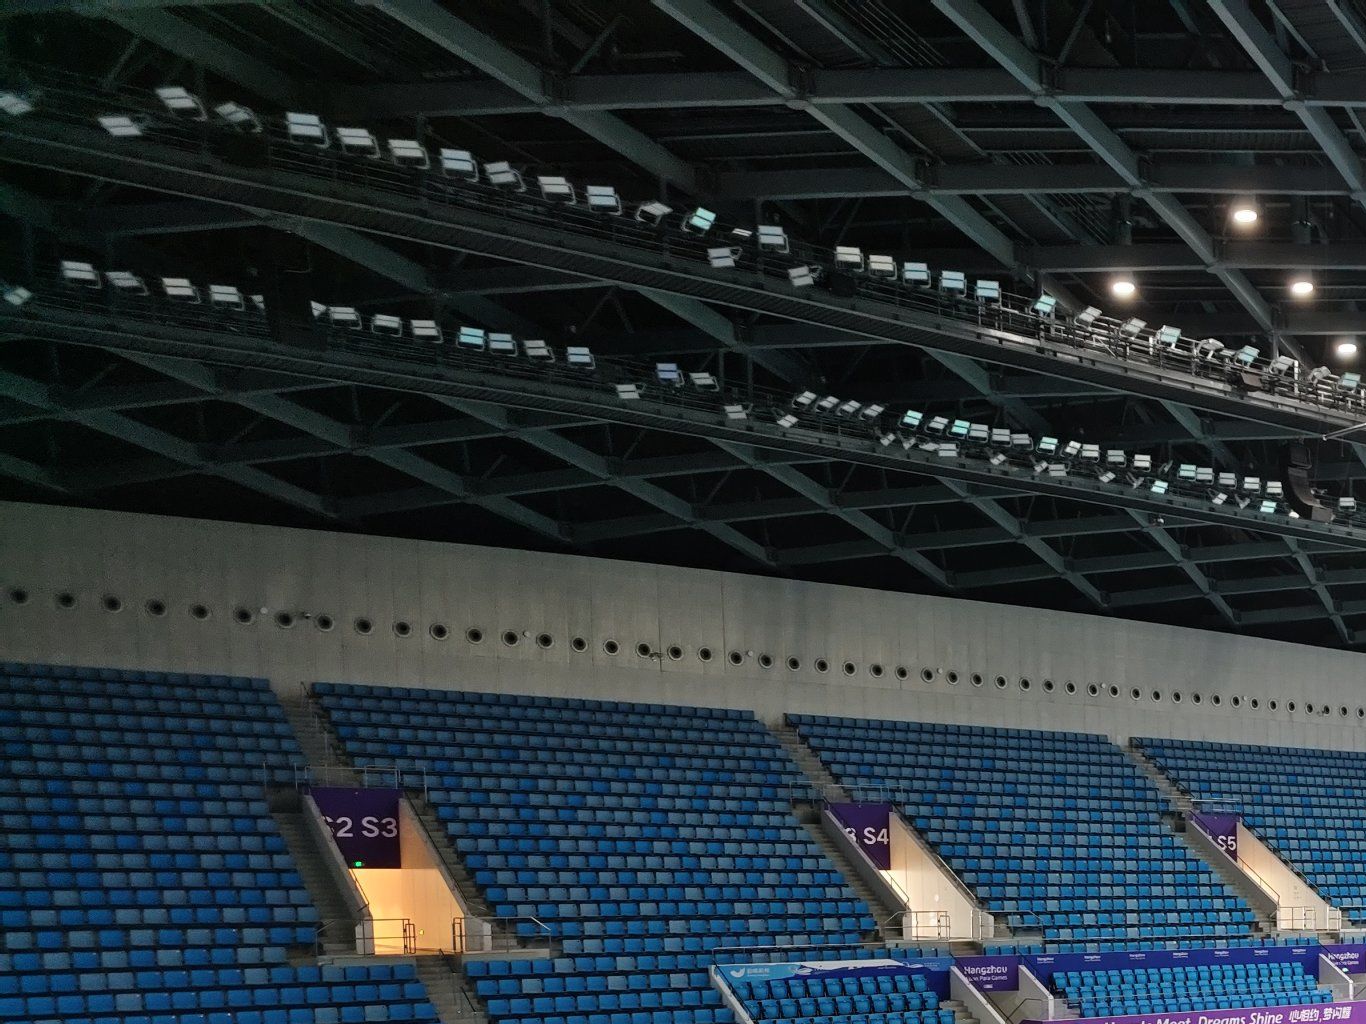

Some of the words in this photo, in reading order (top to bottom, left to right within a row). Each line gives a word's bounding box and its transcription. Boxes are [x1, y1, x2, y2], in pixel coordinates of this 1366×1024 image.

[361, 816, 398, 838] S3
[863, 827, 889, 845] S4
[1217, 835, 1237, 851] S5
[964, 965, 1008, 975] Hangzhou
